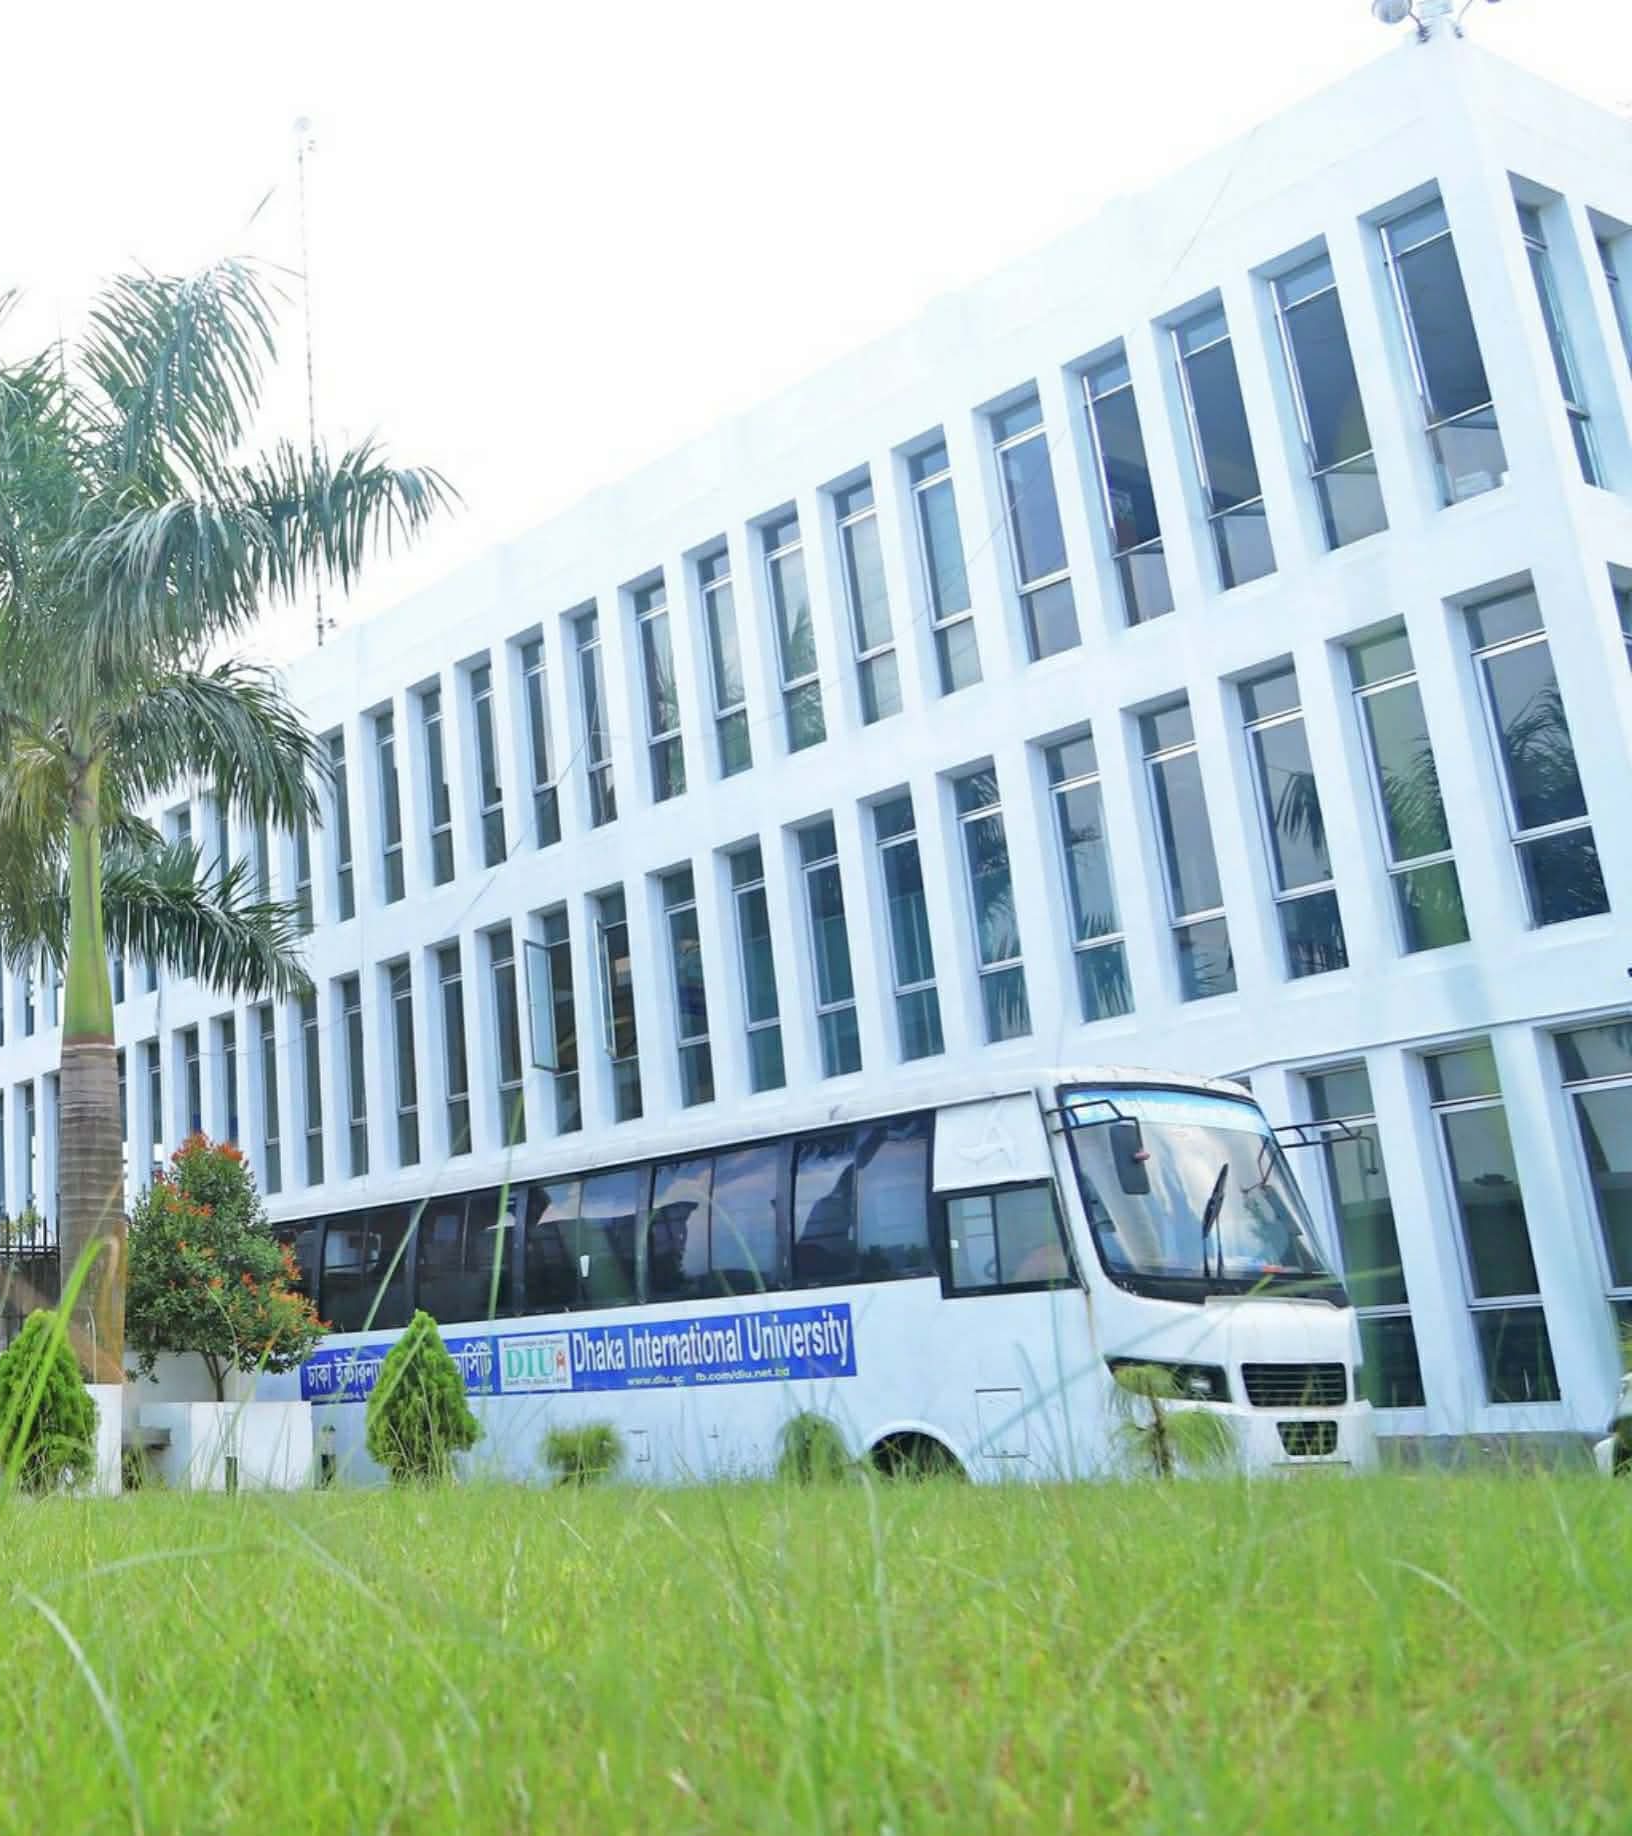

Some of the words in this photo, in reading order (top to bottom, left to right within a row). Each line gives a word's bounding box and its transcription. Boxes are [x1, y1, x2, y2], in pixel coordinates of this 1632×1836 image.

[504, 1345, 555, 1378] DIU
[572, 1329, 625, 1372] Dhaka
[628, 1318, 743, 1369] International
[746, 1309, 848, 1366] University
